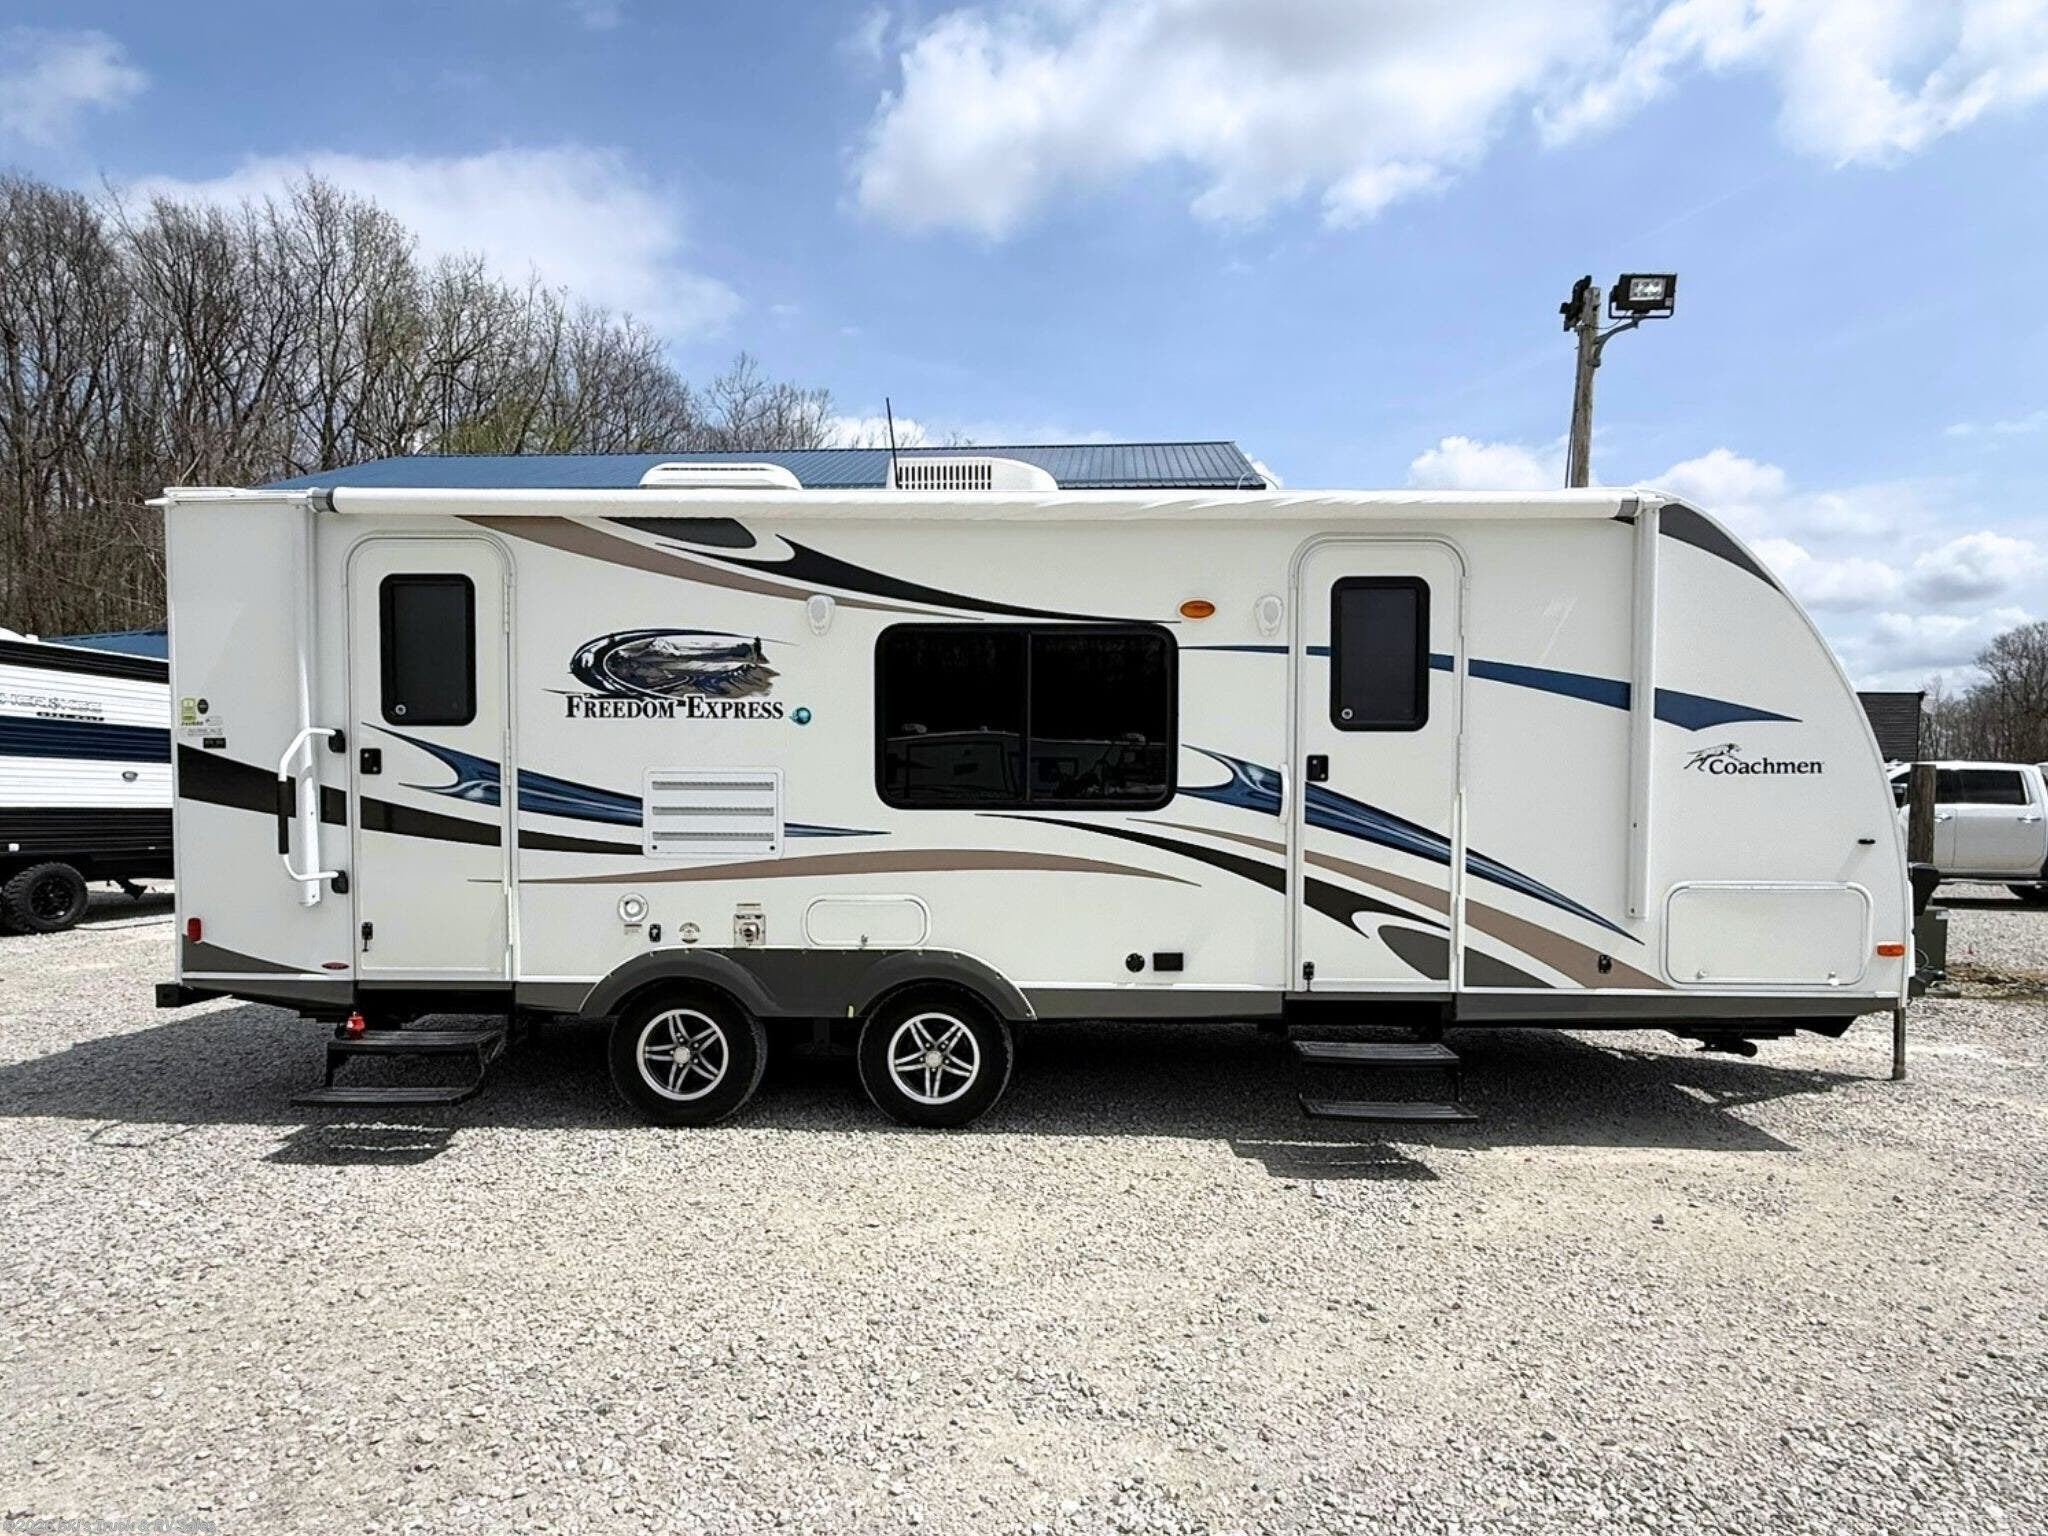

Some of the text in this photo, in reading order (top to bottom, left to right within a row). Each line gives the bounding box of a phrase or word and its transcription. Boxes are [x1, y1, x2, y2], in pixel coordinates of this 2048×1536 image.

[565, 695, 784, 719] FREEDOM EXPRESS
[1709, 757, 1823, 775] Coachmen
